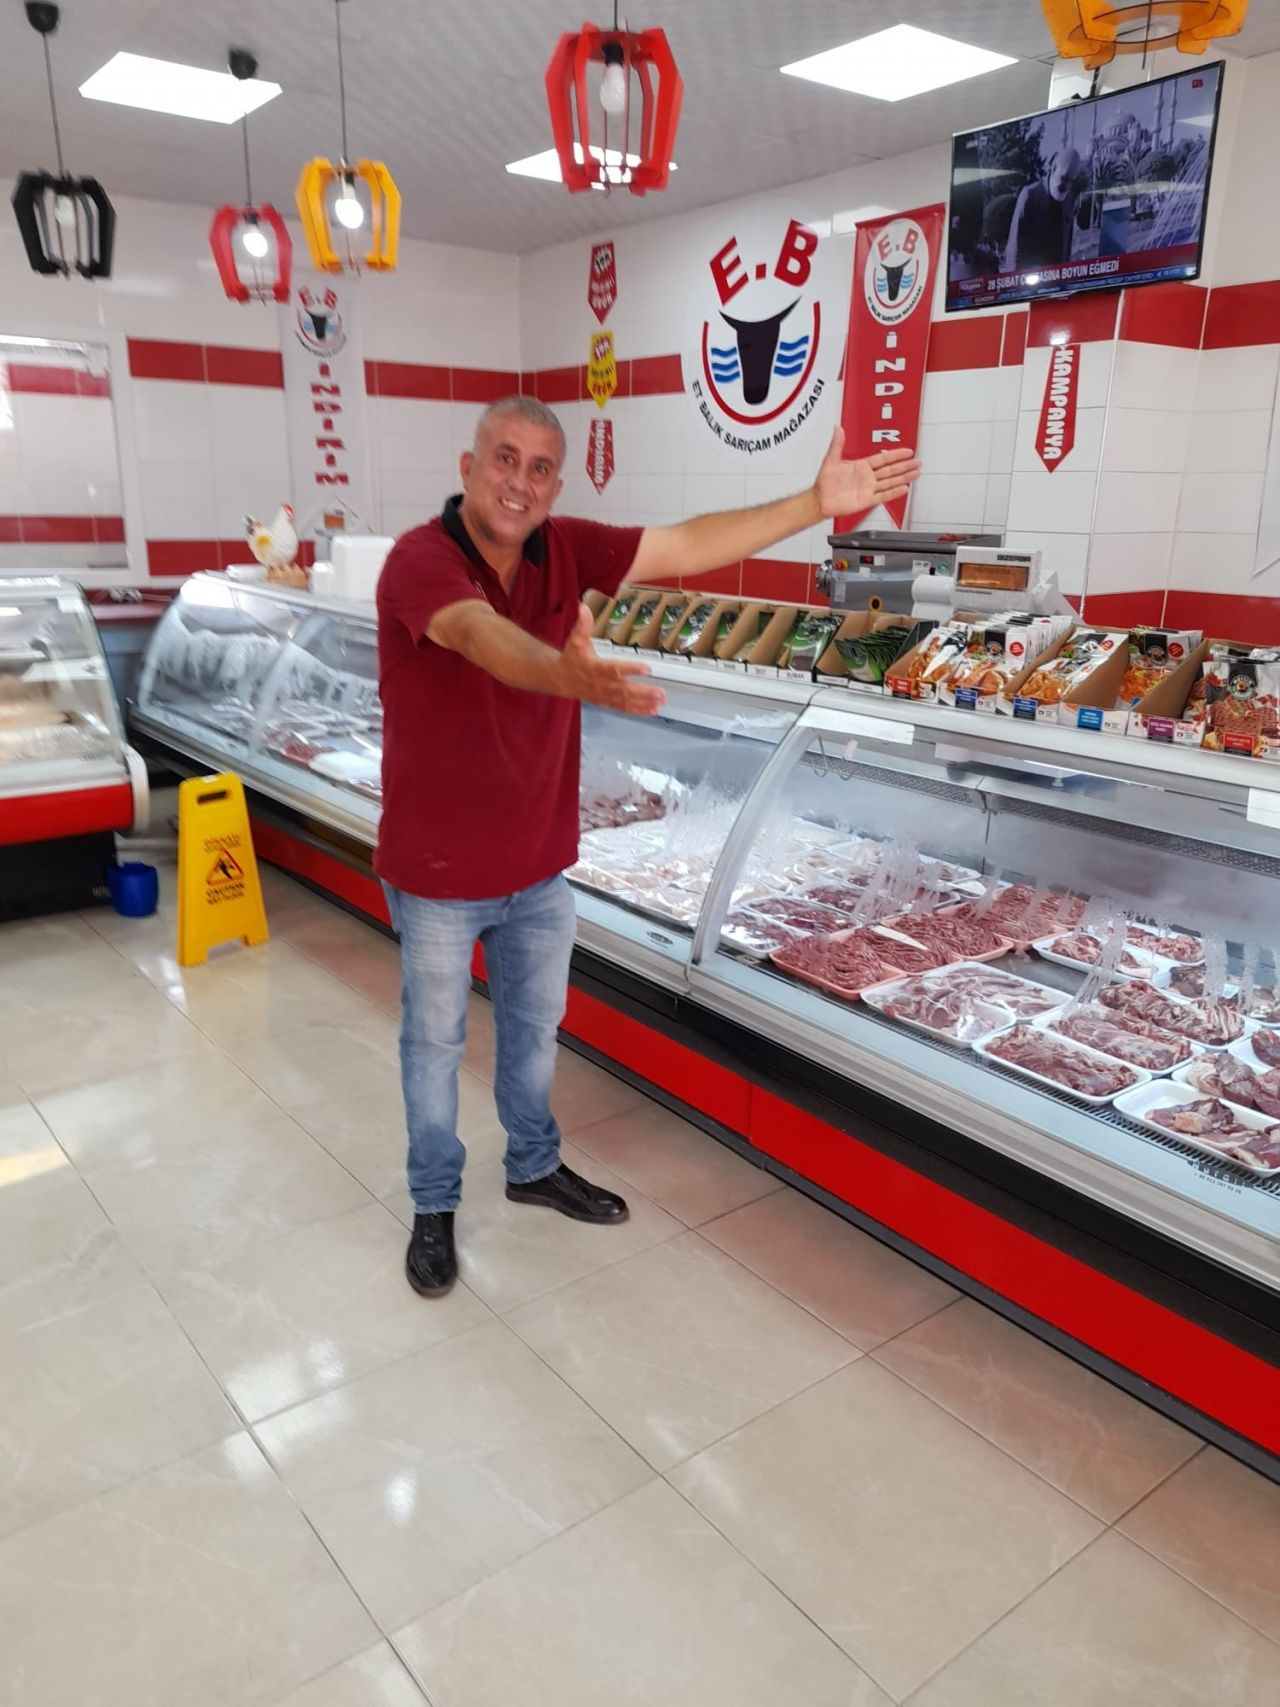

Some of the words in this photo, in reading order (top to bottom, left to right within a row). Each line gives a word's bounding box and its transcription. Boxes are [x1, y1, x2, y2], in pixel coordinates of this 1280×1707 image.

[709, 218, 818, 307] E.B
[1061, 264, 1088, 279] BOYUN
[692, 379, 703, 399] ET
[699, 401, 723, 439] BALIK
[724, 432, 772, 455] SARIÇAM
[773, 379, 826, 446] MAĞAZASI
[1043, 348, 1074, 460] KAMPANYA
